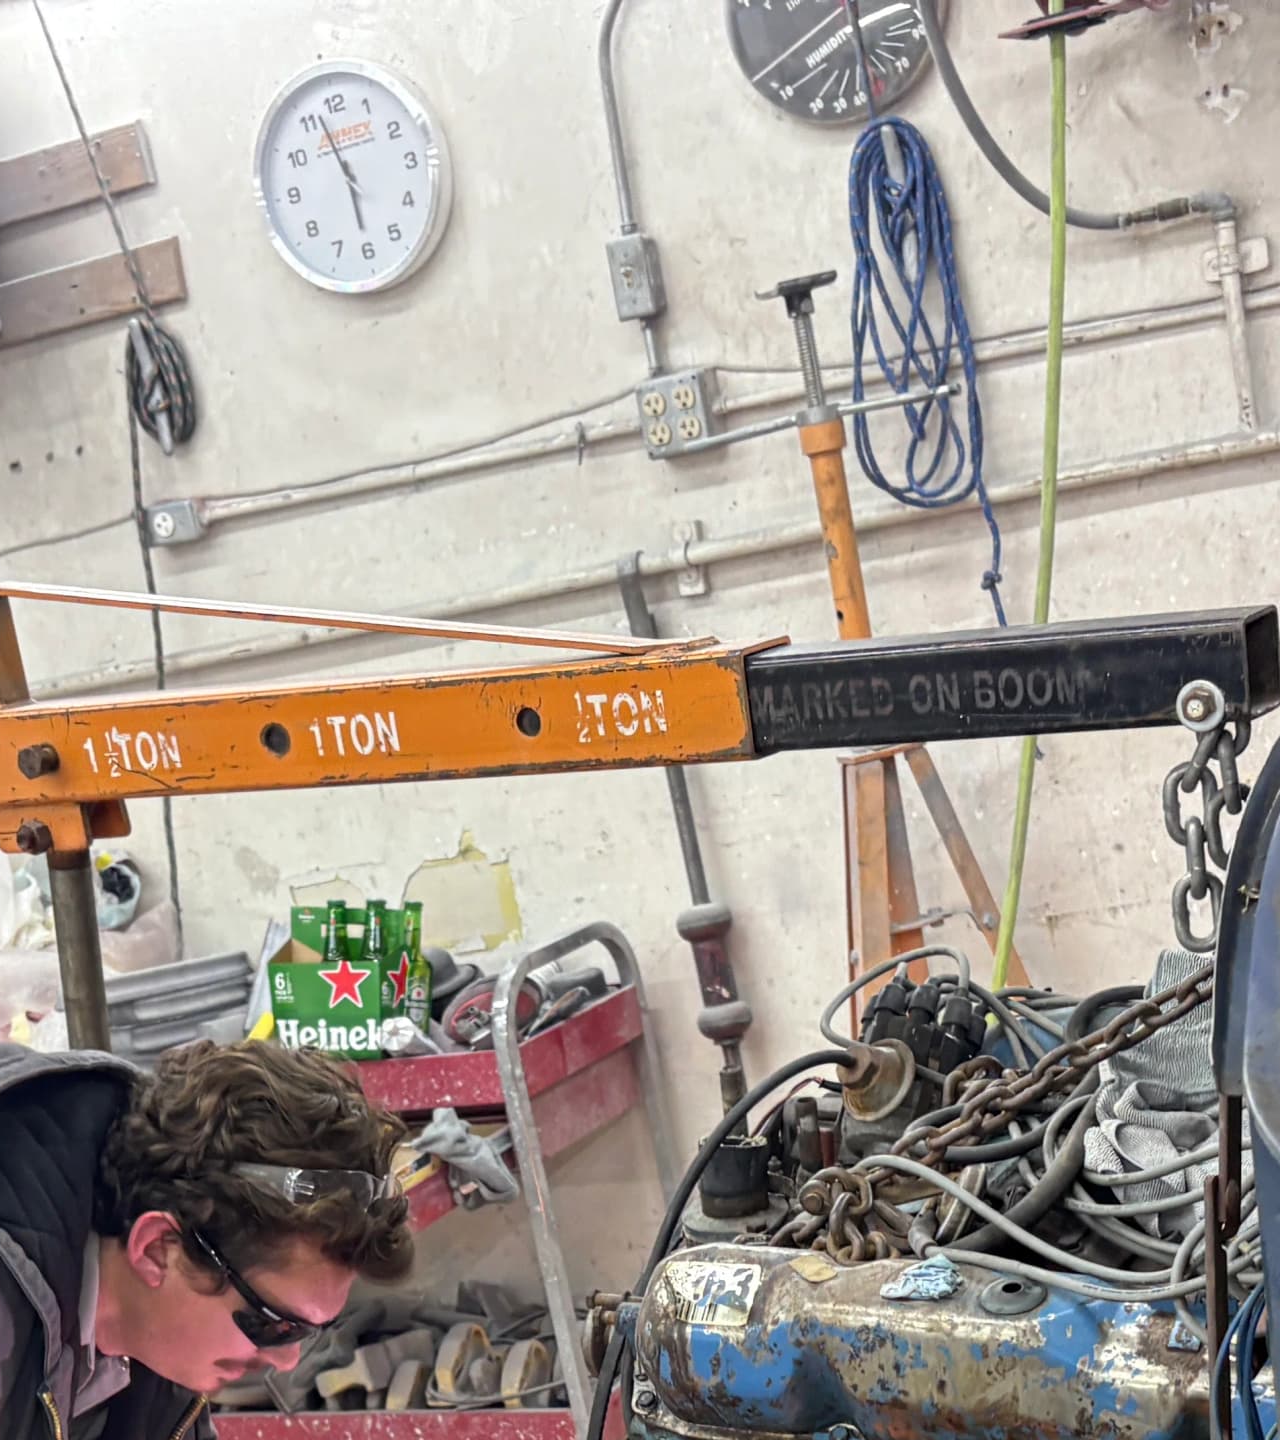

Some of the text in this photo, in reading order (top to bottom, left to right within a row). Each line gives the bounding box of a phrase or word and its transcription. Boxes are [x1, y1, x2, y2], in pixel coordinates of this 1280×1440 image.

[805, 26, 852, 69] HUMIDIT
[895, 56, 910, 74] 70
[779, 85, 794, 100] 10
[853, 90, 867, 106] 40
[323, 94, 346, 114] 12
[361, 98, 371, 115] 1
[809, 97, 824, 114] 20
[832, 97, 847, 113] 30
[299, 114, 318, 133] 11
[387, 121, 401, 140] 2
[287, 149, 308, 168] 10
[404, 152, 418, 169] 3
[287, 187, 301, 204] 9
[402, 191, 414, 207] 4
[305, 220, 319, 237] 8
[387, 224, 401, 241] 5
[331, 240, 343, 258] 7
[361, 243, 375, 260] 6
[751, 676, 894, 724] MARKED
[909, 672, 960, 714] ON
[275, 972, 285, 990] 6
[276, 1018, 381, 1051] Heinek
